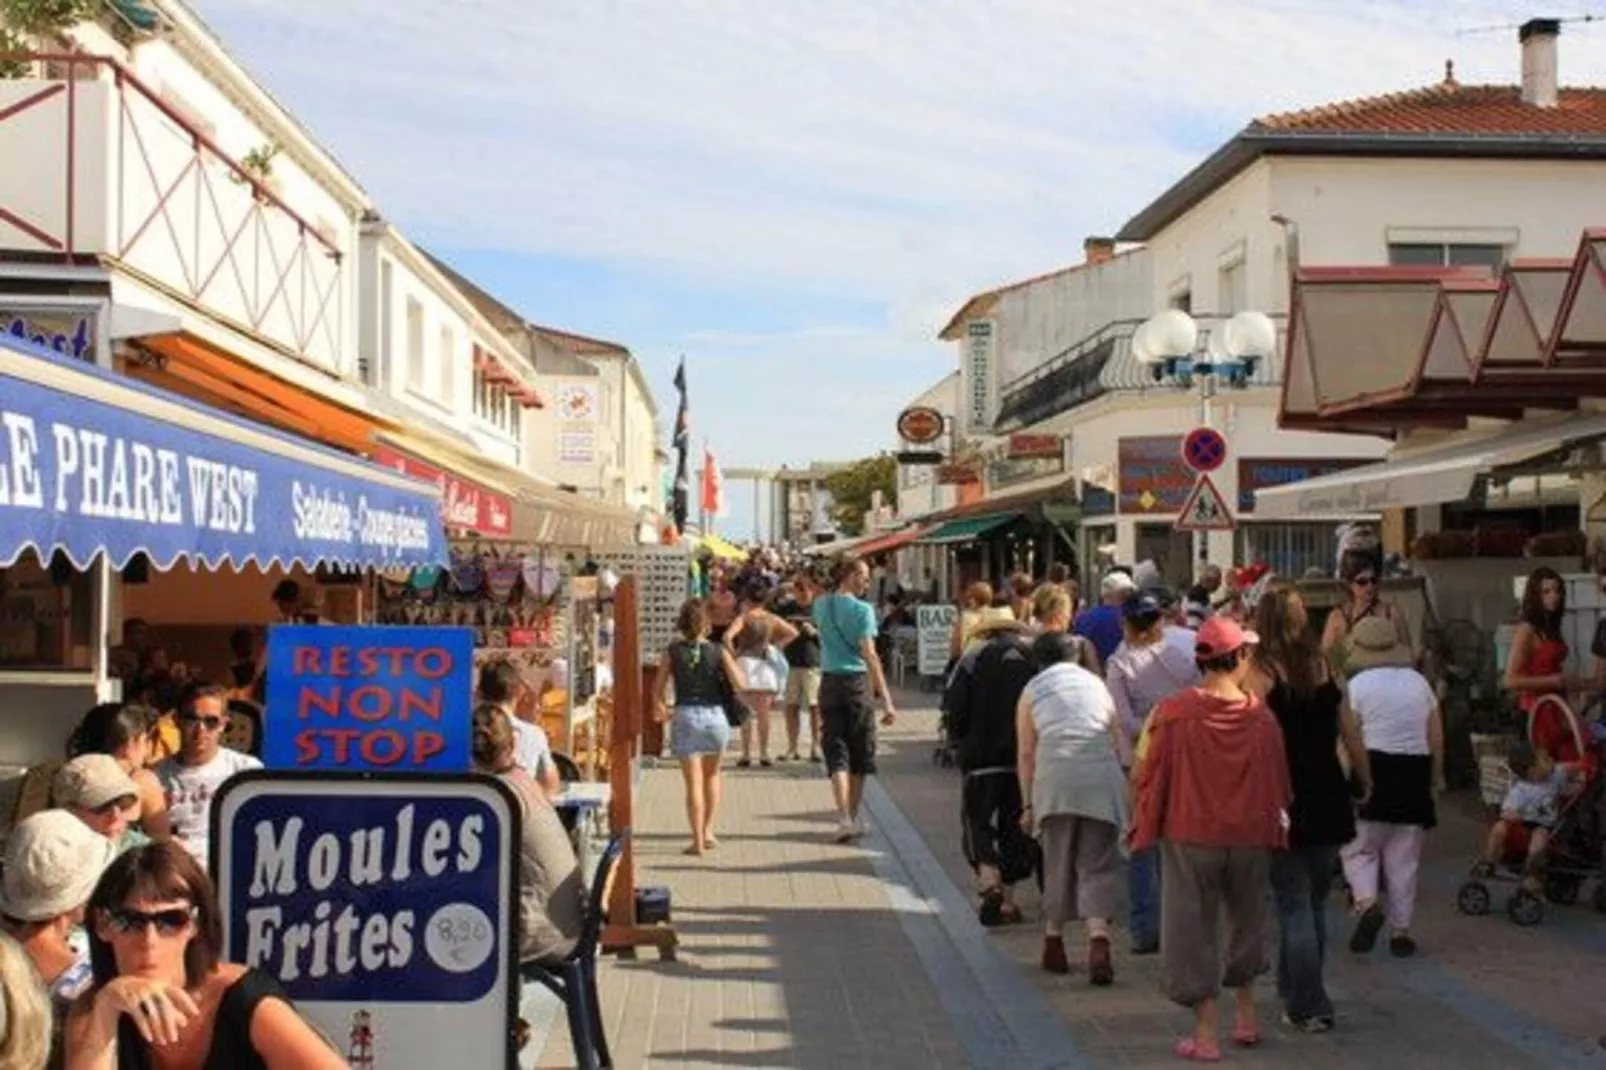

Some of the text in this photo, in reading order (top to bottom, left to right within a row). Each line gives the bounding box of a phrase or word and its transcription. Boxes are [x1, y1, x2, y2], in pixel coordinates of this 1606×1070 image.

[52, 423, 182, 524] PHARE
[185, 456, 259, 533] WEST
[920, 608, 957, 627] BAR
[293, 647, 452, 676] RESTO
[299, 687, 444, 721] NON
[295, 730, 446, 764] STOP
[249, 803, 485, 897] Moules
[245, 901, 414, 981] Frites
